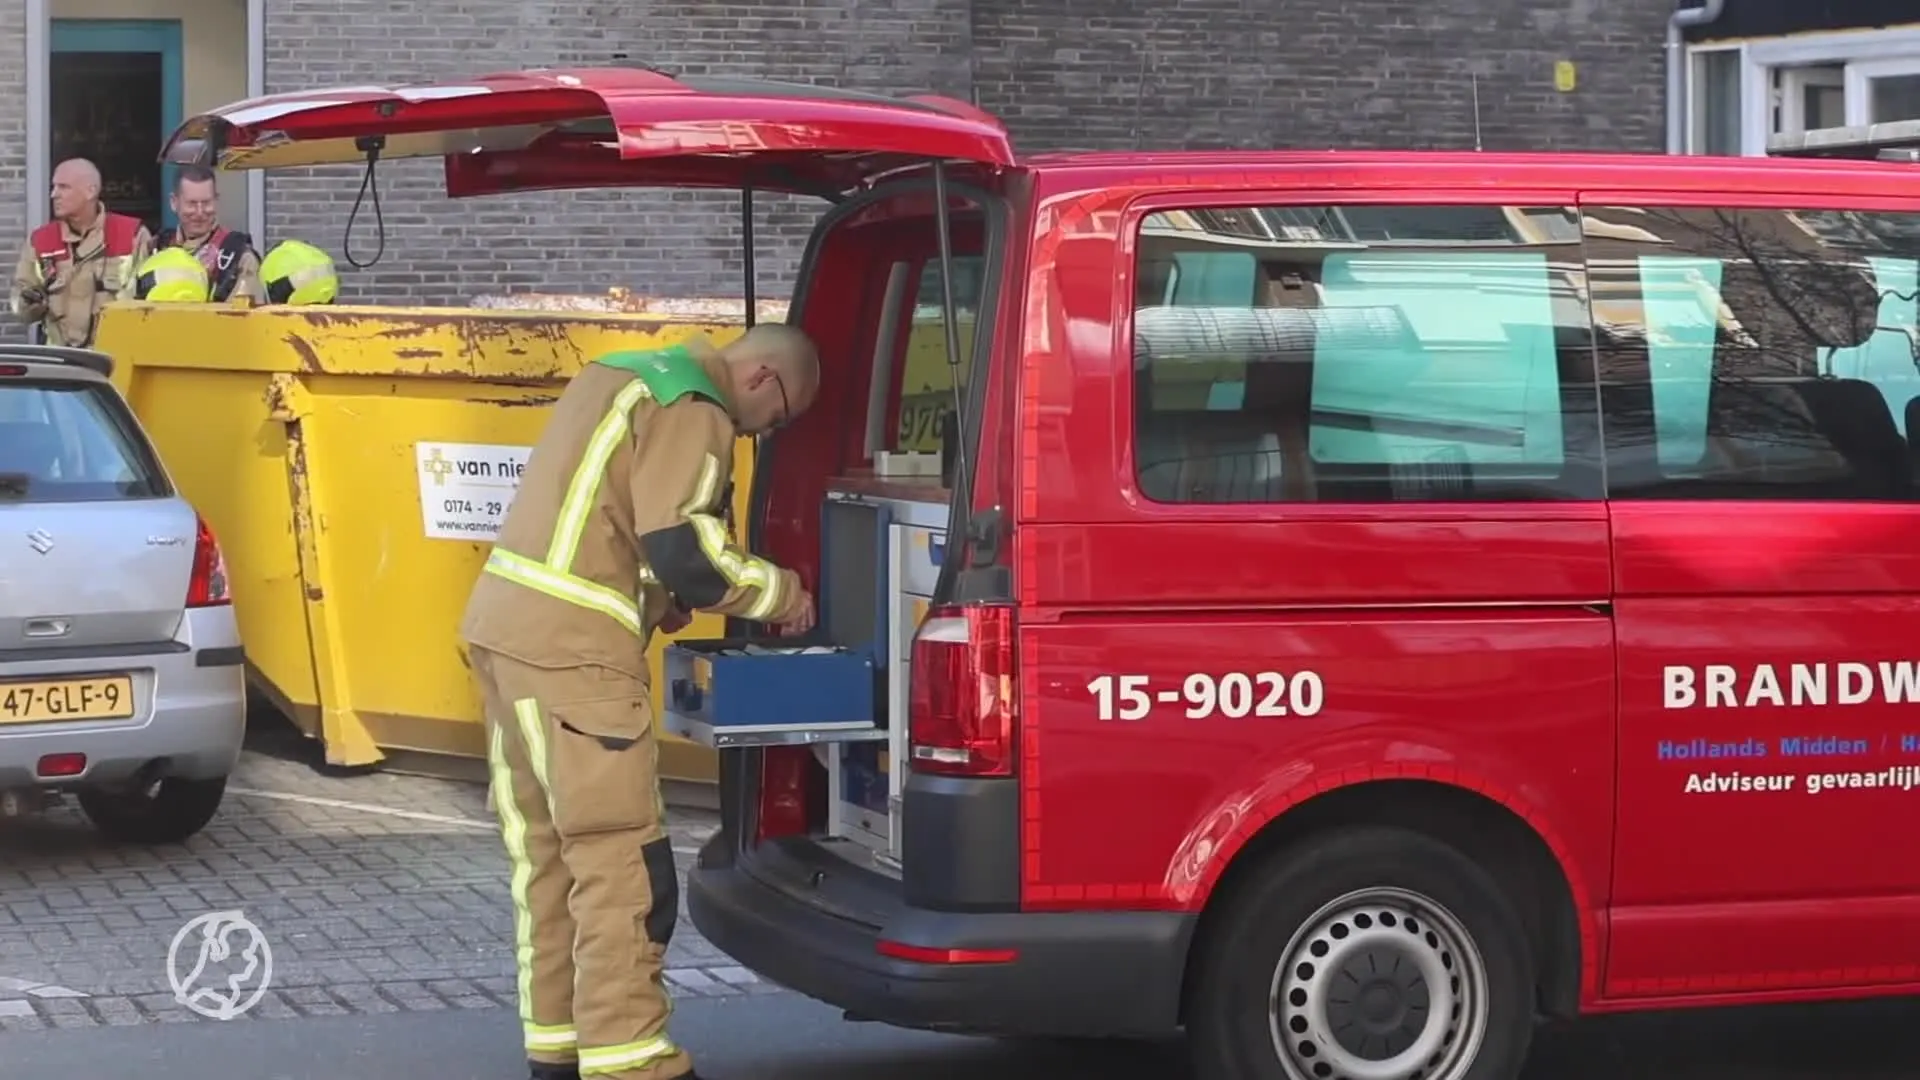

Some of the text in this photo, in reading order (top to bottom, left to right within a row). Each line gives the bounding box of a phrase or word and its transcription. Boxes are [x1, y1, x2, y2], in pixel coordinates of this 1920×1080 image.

[457, 457, 526, 478] van nie
[444, 499, 472, 513] 0174
[487, 502, 502, 516] 29
[1087, 671, 1323, 720] 15-9020
[1664, 662, 1920, 708] BRANDW
[3, 683, 119, 717] 47-GLF-9
[1657, 739, 1767, 760] Hollands
[1780, 735, 1867, 757] Midden
[1684, 771, 1795, 793] Adviseur
